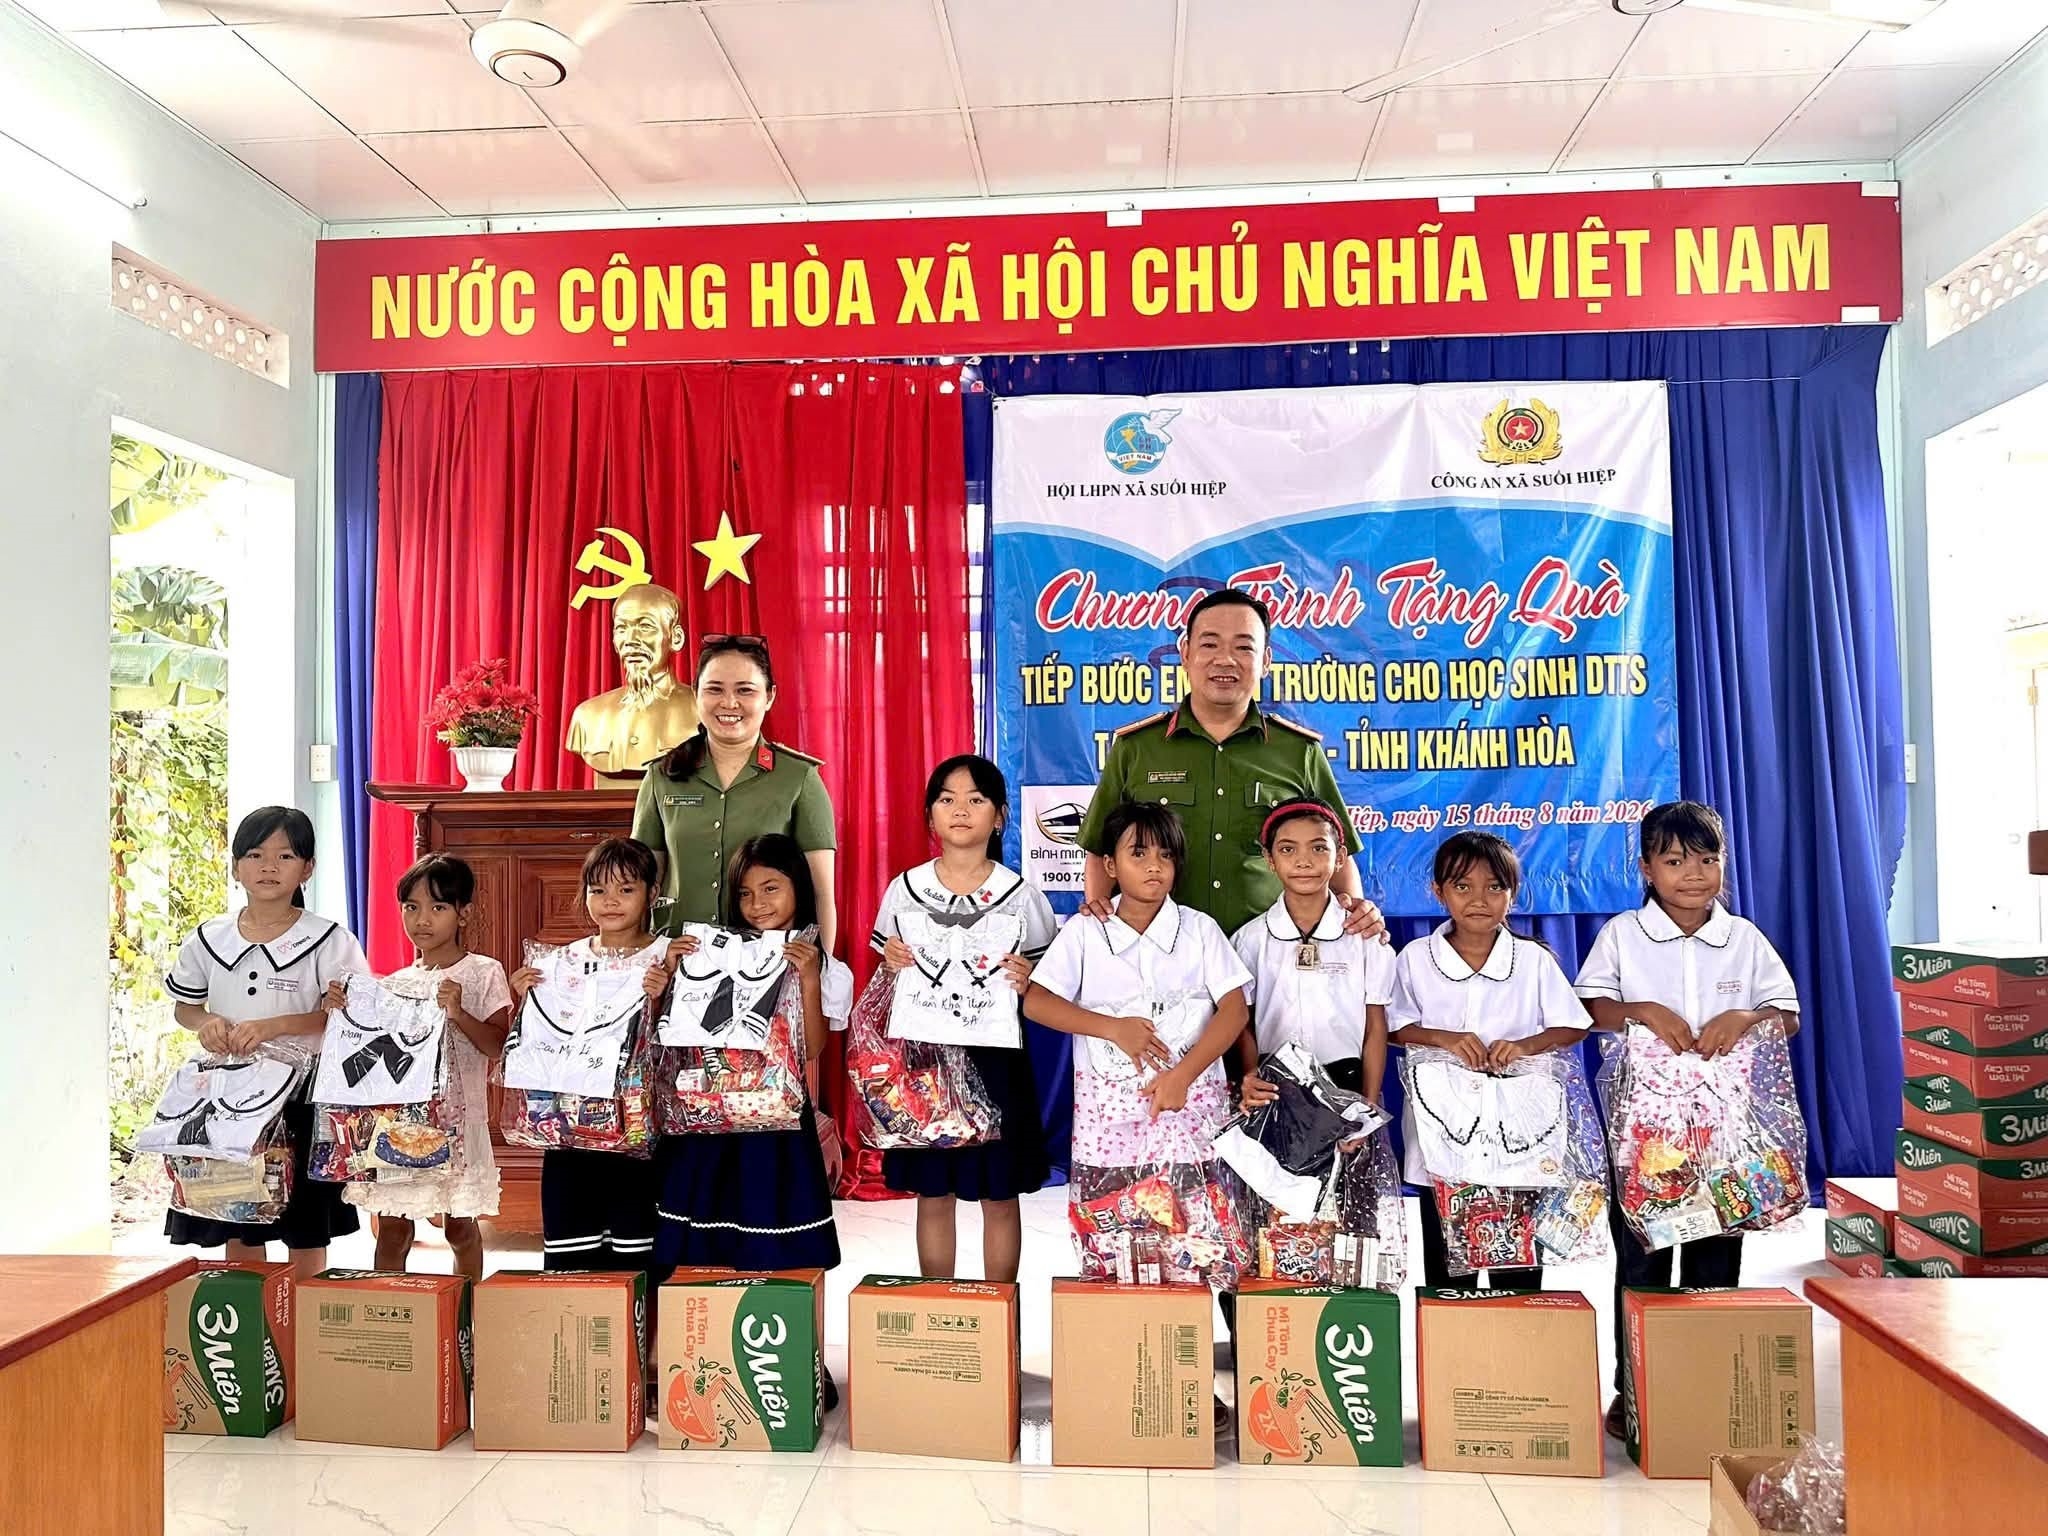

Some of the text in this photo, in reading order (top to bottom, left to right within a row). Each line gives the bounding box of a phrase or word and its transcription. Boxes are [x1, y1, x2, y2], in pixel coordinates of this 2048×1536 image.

[370, 218, 1830, 346] NƯỚC CỘNG HÒA XÃ HỘI CHỦ NGHĨA VIỆT NAM
[1047, 478, 1227, 500] HỘI LHPN XÃ SUỐI HIỆP
[1431, 468, 1617, 489] CÔNG AN XÃ SUỐI HIỆP
[1226, 562, 1365, 630] Trình
[1377, 557, 1508, 648] Tặng
[1509, 556, 1630, 643] Quà
[1021, 652, 1074, 705] TIẾP
[1082, 654, 1152, 704] BƯỚC
[1270, 654, 1376, 703] TRƯỜNG
[1384, 661, 1439, 701] CHO
[1448, 660, 1505, 709] HỌC
[1510, 656, 1577, 698] SINH
[1585, 654, 1648, 696] DTTS
[1345, 717, 1408, 770] TỈNH
[1417, 720, 1508, 769] KHÁNH
[1516, 716, 1576, 766] HÒA
[1392, 806, 1440, 831] ngày
[1446, 804, 1470, 827] 15
[1474, 802, 1535, 829] tháng
[1539, 802, 1552, 824] 8
[1556, 801, 1601, 823] năm
[1042, 872, 1071, 882] 1900
[1953, 985, 1991, 999] Chua Cay
[684, 1297, 697, 1361] Chua Cay
[697, 1312, 709, 1345] Tôm
[1264, 1306, 1278, 1371] Chua Cay
[1278, 1323, 1290, 1356] Tôm
